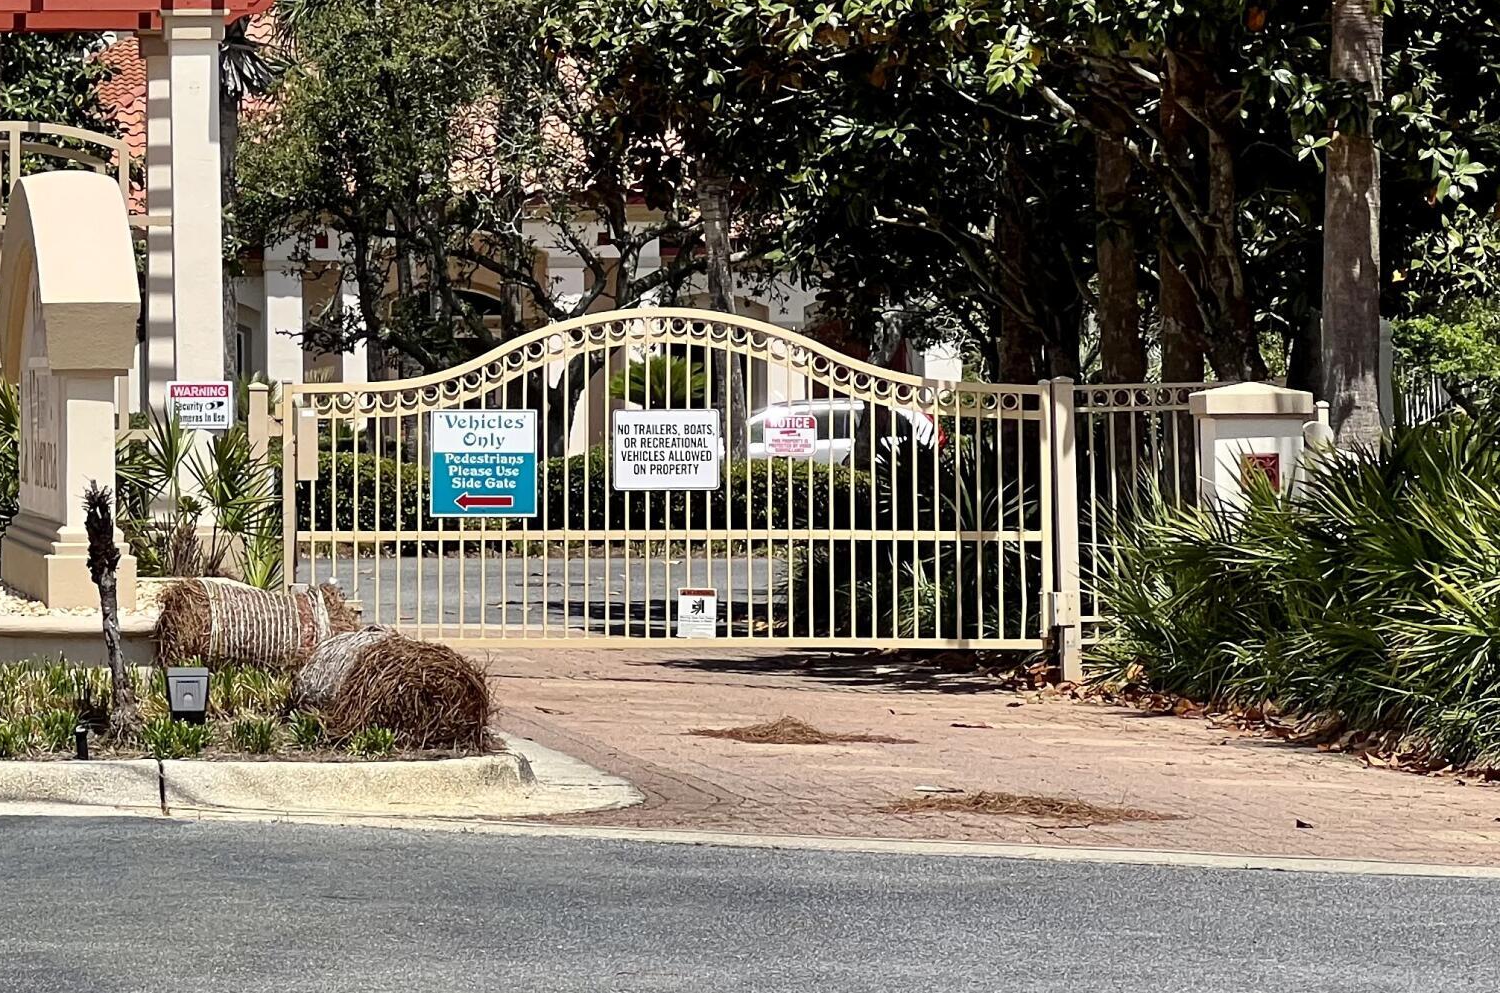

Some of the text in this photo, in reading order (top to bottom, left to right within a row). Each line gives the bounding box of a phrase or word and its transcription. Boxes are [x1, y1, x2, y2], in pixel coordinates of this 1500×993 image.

[173, 386, 227, 397] WARNING
[179, 414, 203, 423] ameras
[213, 412, 226, 422] Use
[445, 414, 524, 430] Vehicles
[617, 424, 715, 436] NO TRAILERS, BOATS,
[463, 432, 505, 449] Only
[624, 437, 708, 448] OR RECREATIONAL
[444, 453, 524, 466] Pedestrians
[621, 450, 712, 461] VEHICLES ALLOWED
[448, 465, 519, 476] Please Use
[633, 464, 699, 475] ON PROPERTY
[451, 477, 516, 488] Side Gate
